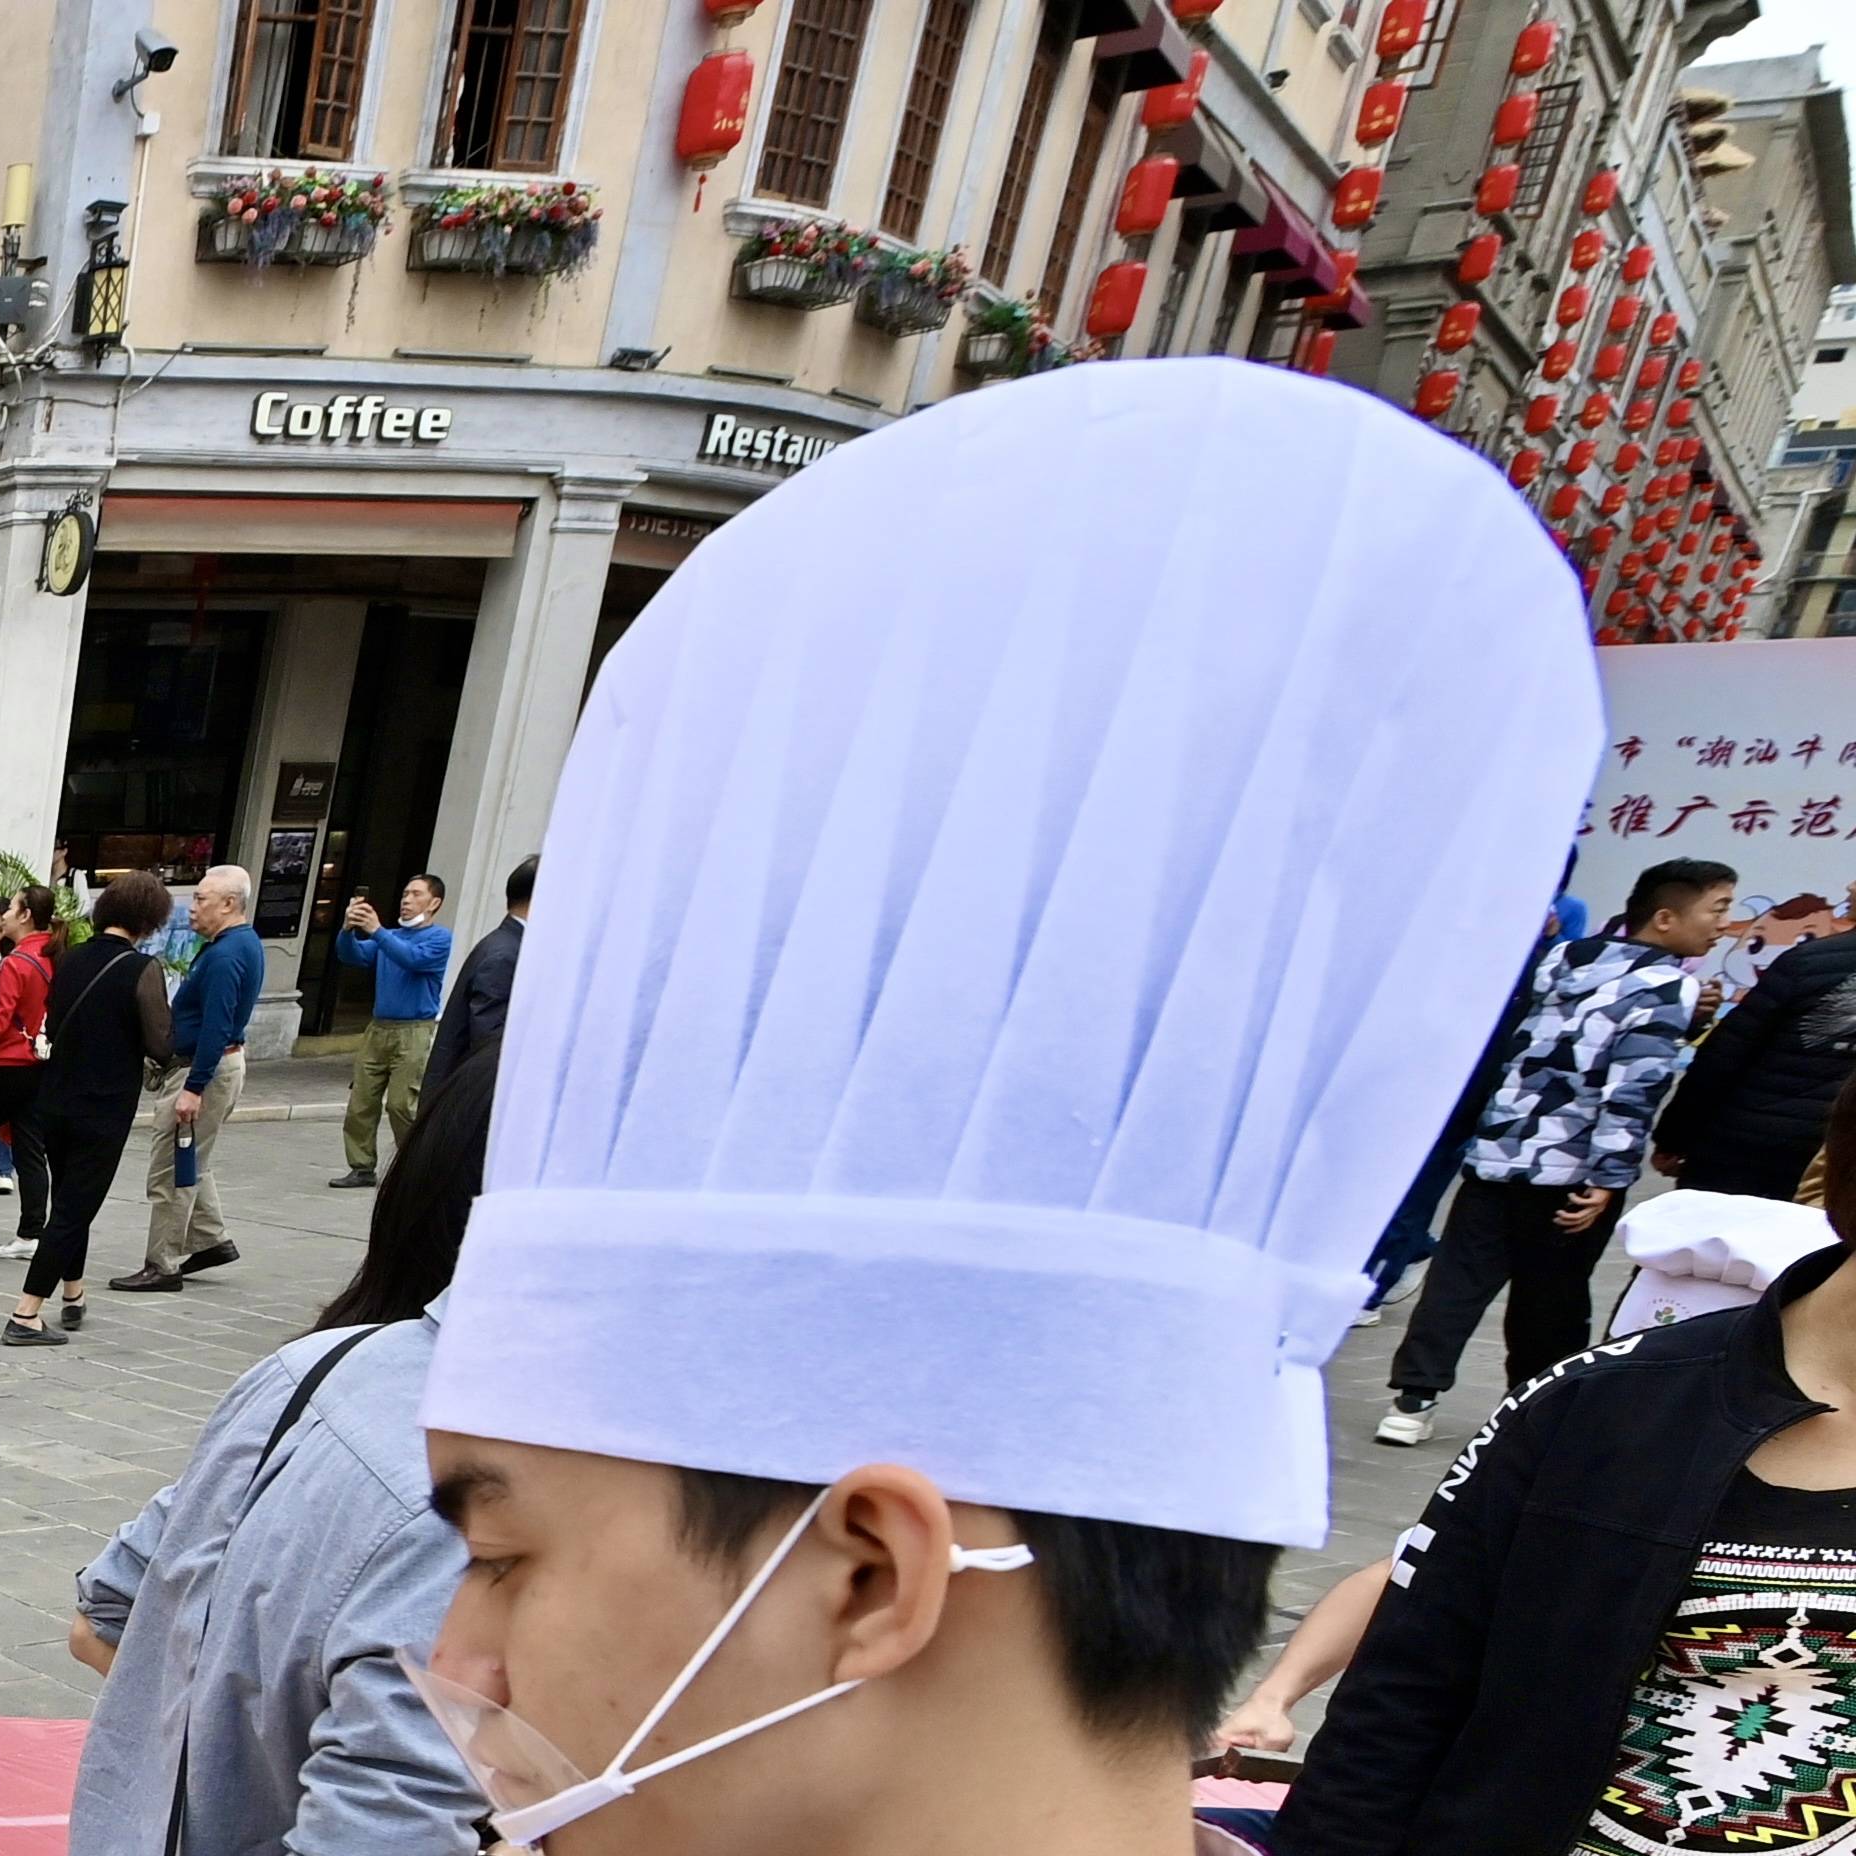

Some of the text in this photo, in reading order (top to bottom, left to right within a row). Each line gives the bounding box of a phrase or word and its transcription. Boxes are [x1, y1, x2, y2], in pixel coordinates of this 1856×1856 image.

[253, 391, 453, 440] Coffee
[1577, 793, 1856, 841] 推广示范
